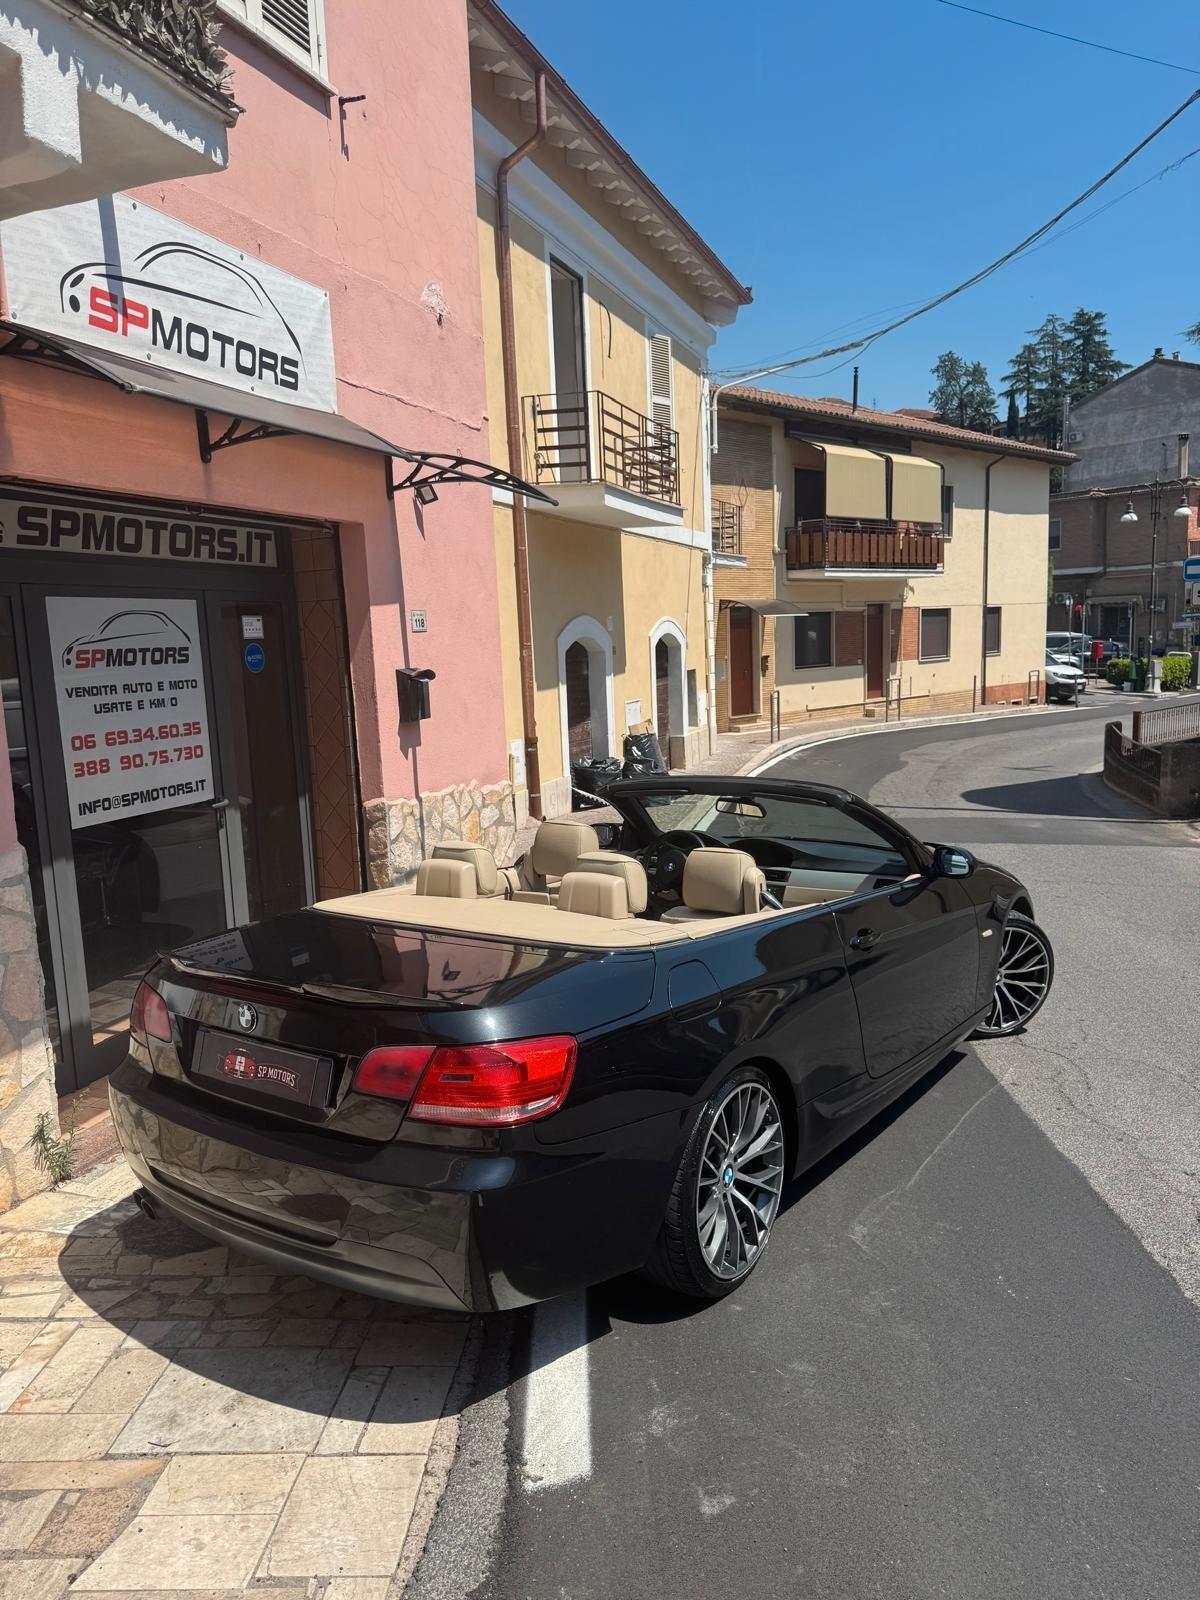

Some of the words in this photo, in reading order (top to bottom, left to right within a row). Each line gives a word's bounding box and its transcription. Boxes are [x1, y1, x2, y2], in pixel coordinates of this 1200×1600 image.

[88, 286, 299, 391] SPMOTORS
[17, 505, 274, 564] SPMOTORS.IT
[74, 646, 190, 669] SPMOTORS
[65, 684, 118, 699] VENDITA
[123, 682, 153, 695] AUTO
[157, 681, 165, 692] E
[169, 679, 198, 691] MOTO
[94, 701, 133, 714] USATE
[137, 700, 145, 710] E
[71, 734, 97, 751] 06
[104, 721, 202, 747] 69.34.60.35
[73, 758, 111, 778] 388
[120, 745, 204, 770] 90.75.730
[78, 779, 206, 816] INFO@SPMOTORS.IT
[257, 1065, 268, 1078] SP
[268, 1067, 296, 1087] MOTORS
